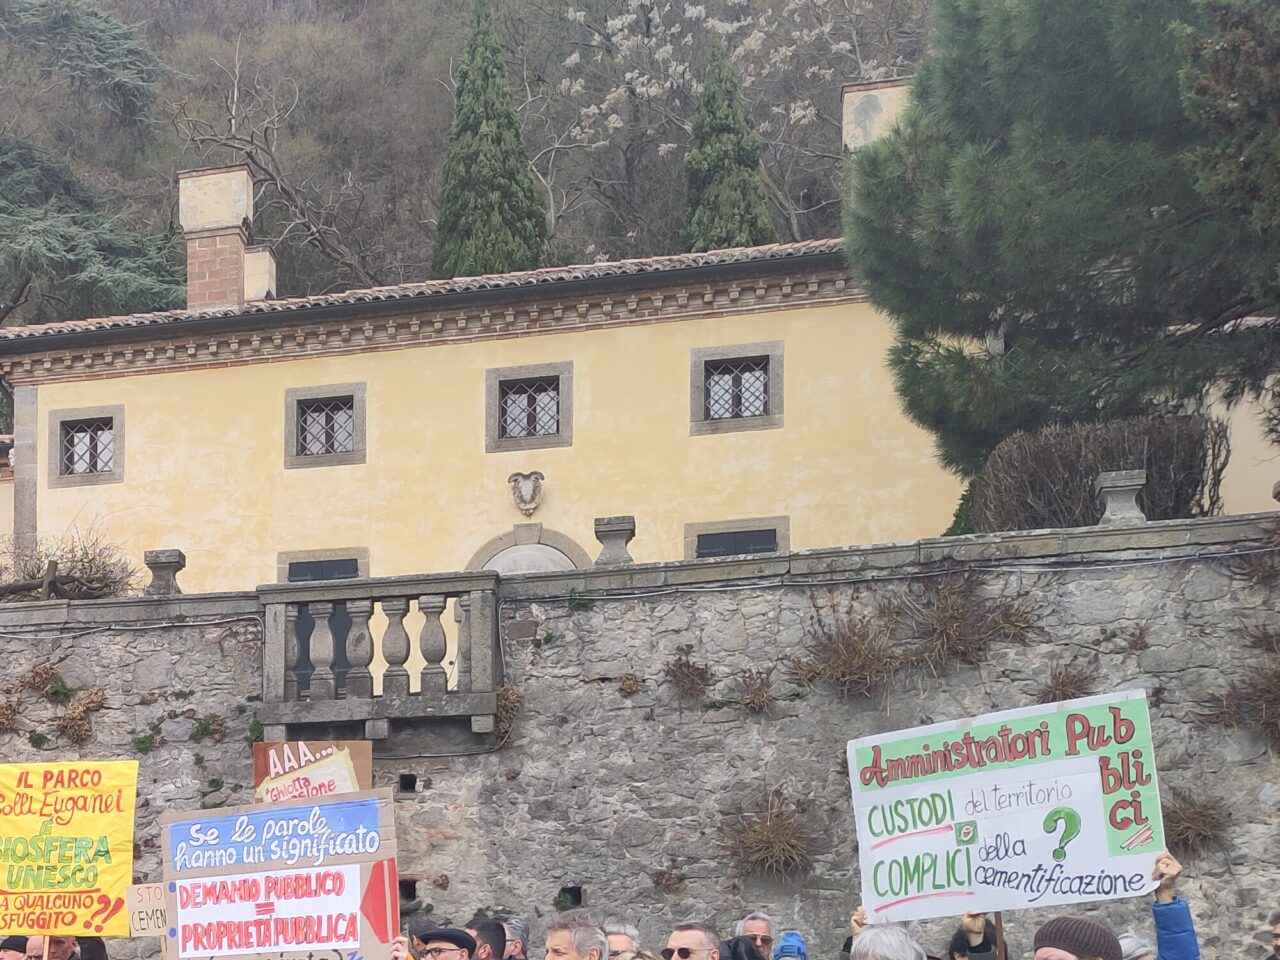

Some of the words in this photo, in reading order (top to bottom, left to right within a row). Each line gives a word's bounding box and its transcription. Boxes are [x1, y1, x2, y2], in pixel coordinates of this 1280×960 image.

[268, 741, 333, 779] AAA...
[860, 721, 1051, 788] Amministratori
[1065, 706, 1135, 756] Pub
[16, 771, 33, 789] IL
[42, 769, 102, 790] PARCO
[1099, 749, 1151, 795] bli
[39, 788, 125, 826] Euganei
[868, 789, 955, 838] CUSTODI
[965, 788, 987, 816] del
[994, 780, 1073, 812] territorio
[1109, 791, 1149, 830] ci
[189, 824, 220, 847] Se
[231, 815, 258, 843] le
[262, 807, 331, 844] parole
[978, 832, 1028, 863] della
[1042, 807, 1081, 862] ?
[175, 841, 237, 872] hanno
[242, 844, 265, 864] un
[270, 825, 380, 867] significato
[7, 865, 99, 890] UNESCO
[179, 876, 261, 910] DEMANIO
[264, 870, 345, 902] PUBBLICO
[873, 847, 972, 898] COMPLICI
[974, 863, 1145, 902] cementificazione
[14, 895, 94, 912] QUALCUNO
[136, 886, 163, 903] STO
[131, 909, 167, 932] CEMEN
[274, 912, 359, 946] PUBBLICA
